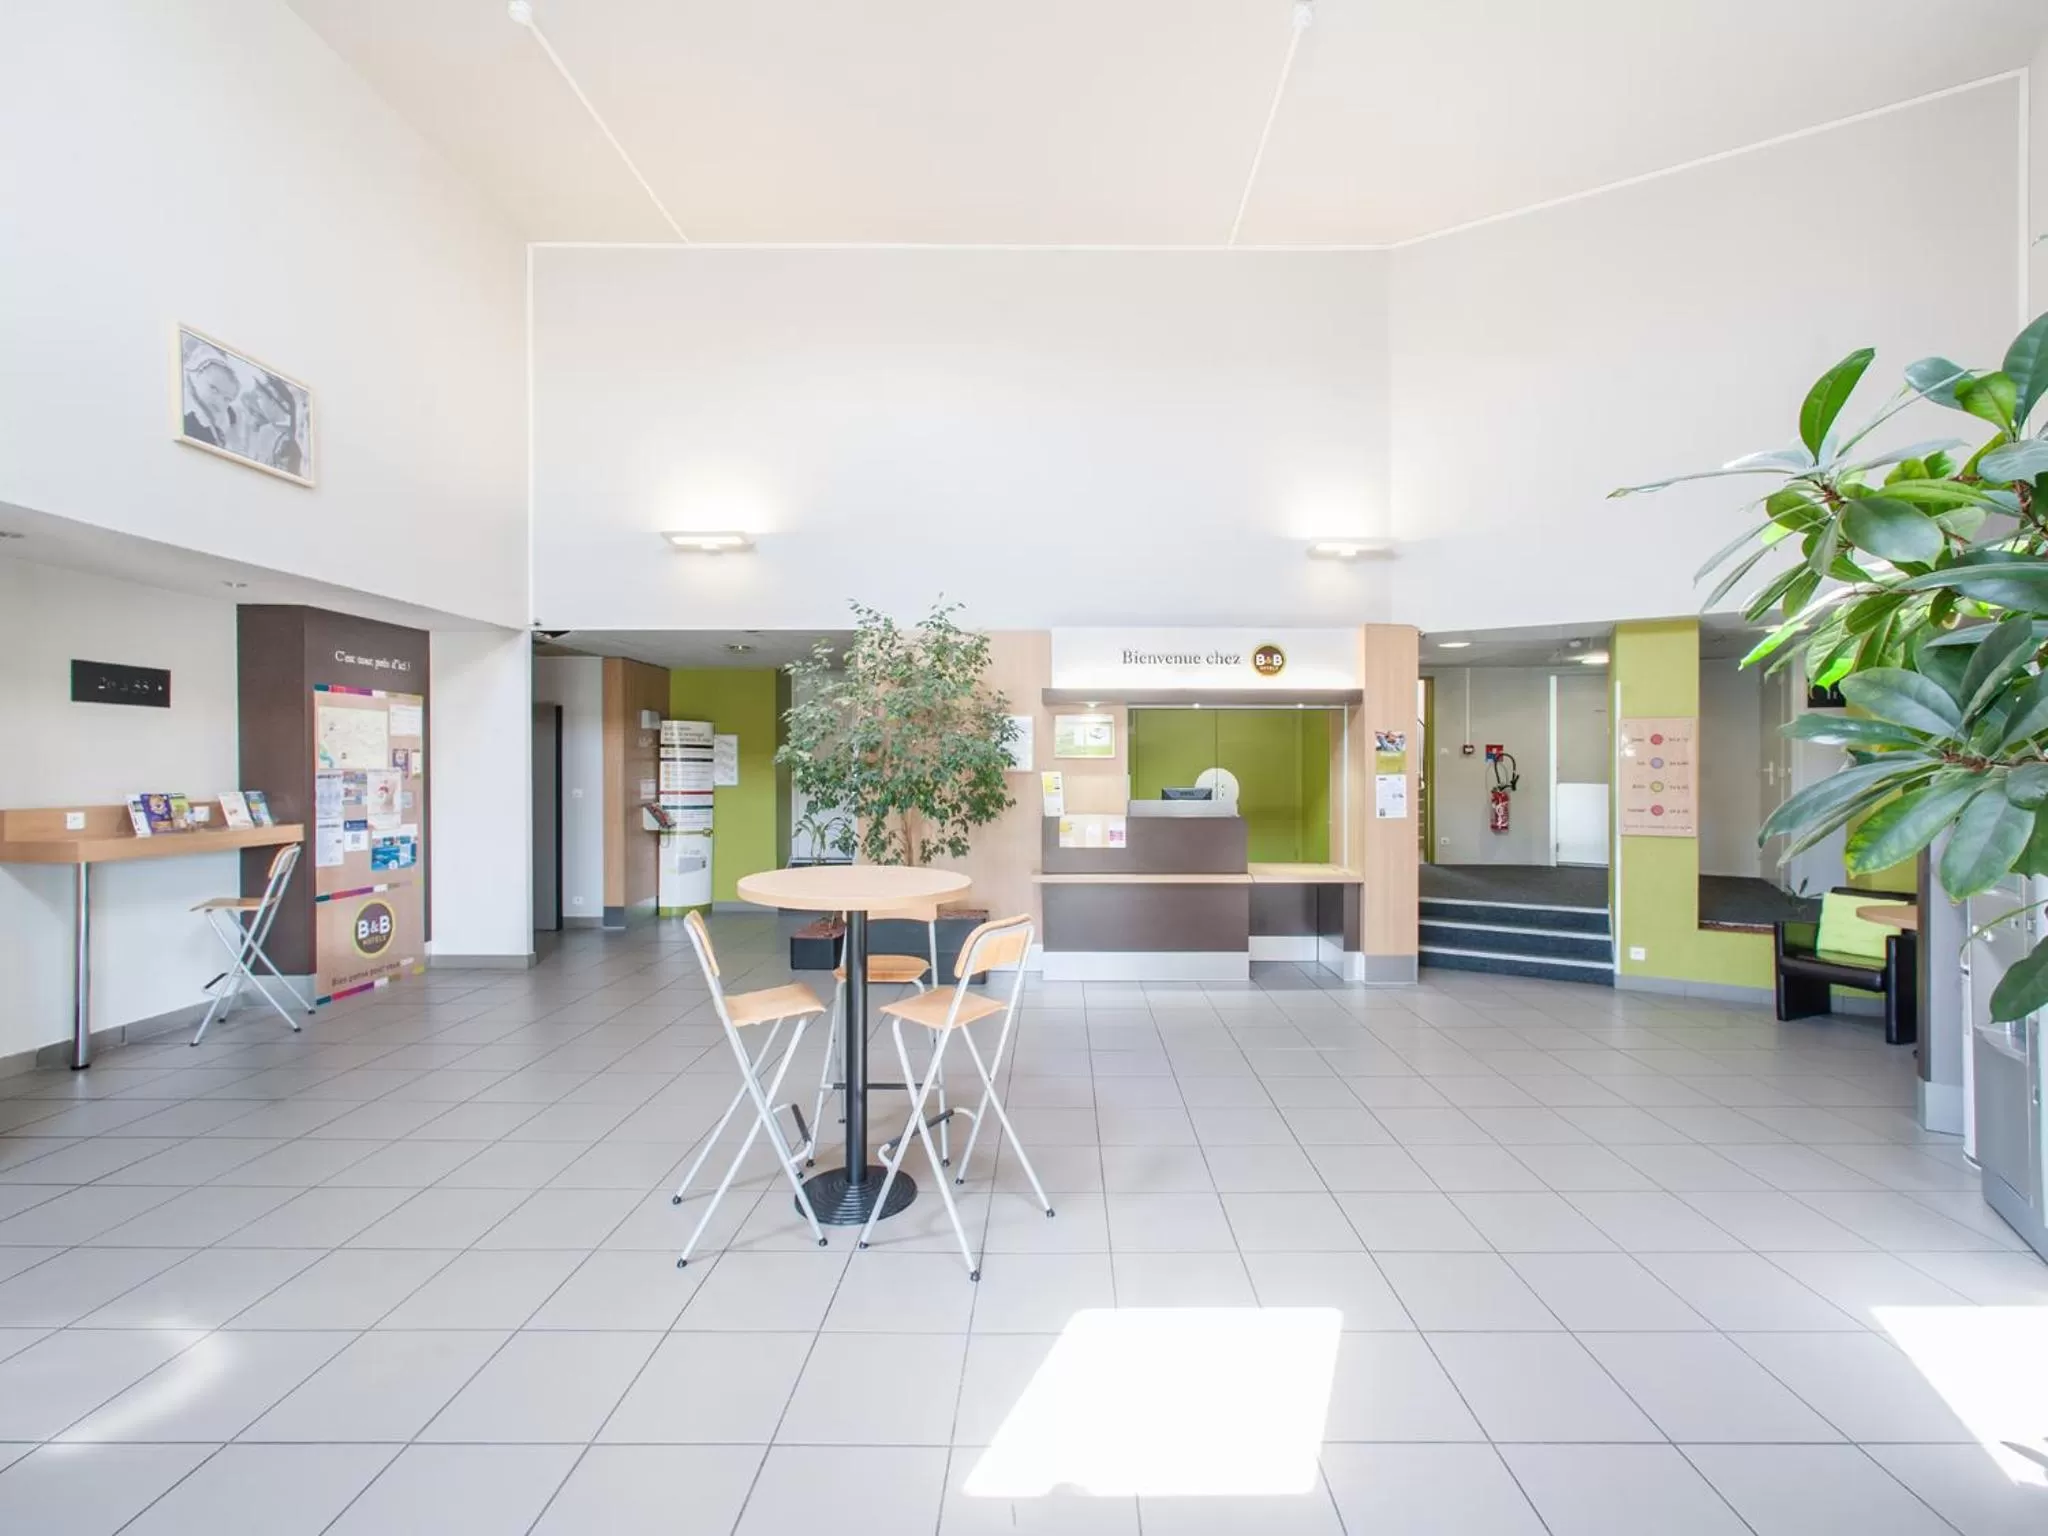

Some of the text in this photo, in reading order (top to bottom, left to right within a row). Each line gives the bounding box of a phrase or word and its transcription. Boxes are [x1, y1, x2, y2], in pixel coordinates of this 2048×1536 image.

[1122, 650, 1241, 665] Bienvenue chez
[1255, 653, 1283, 666] B&B
[358, 915, 391, 940] B&B
